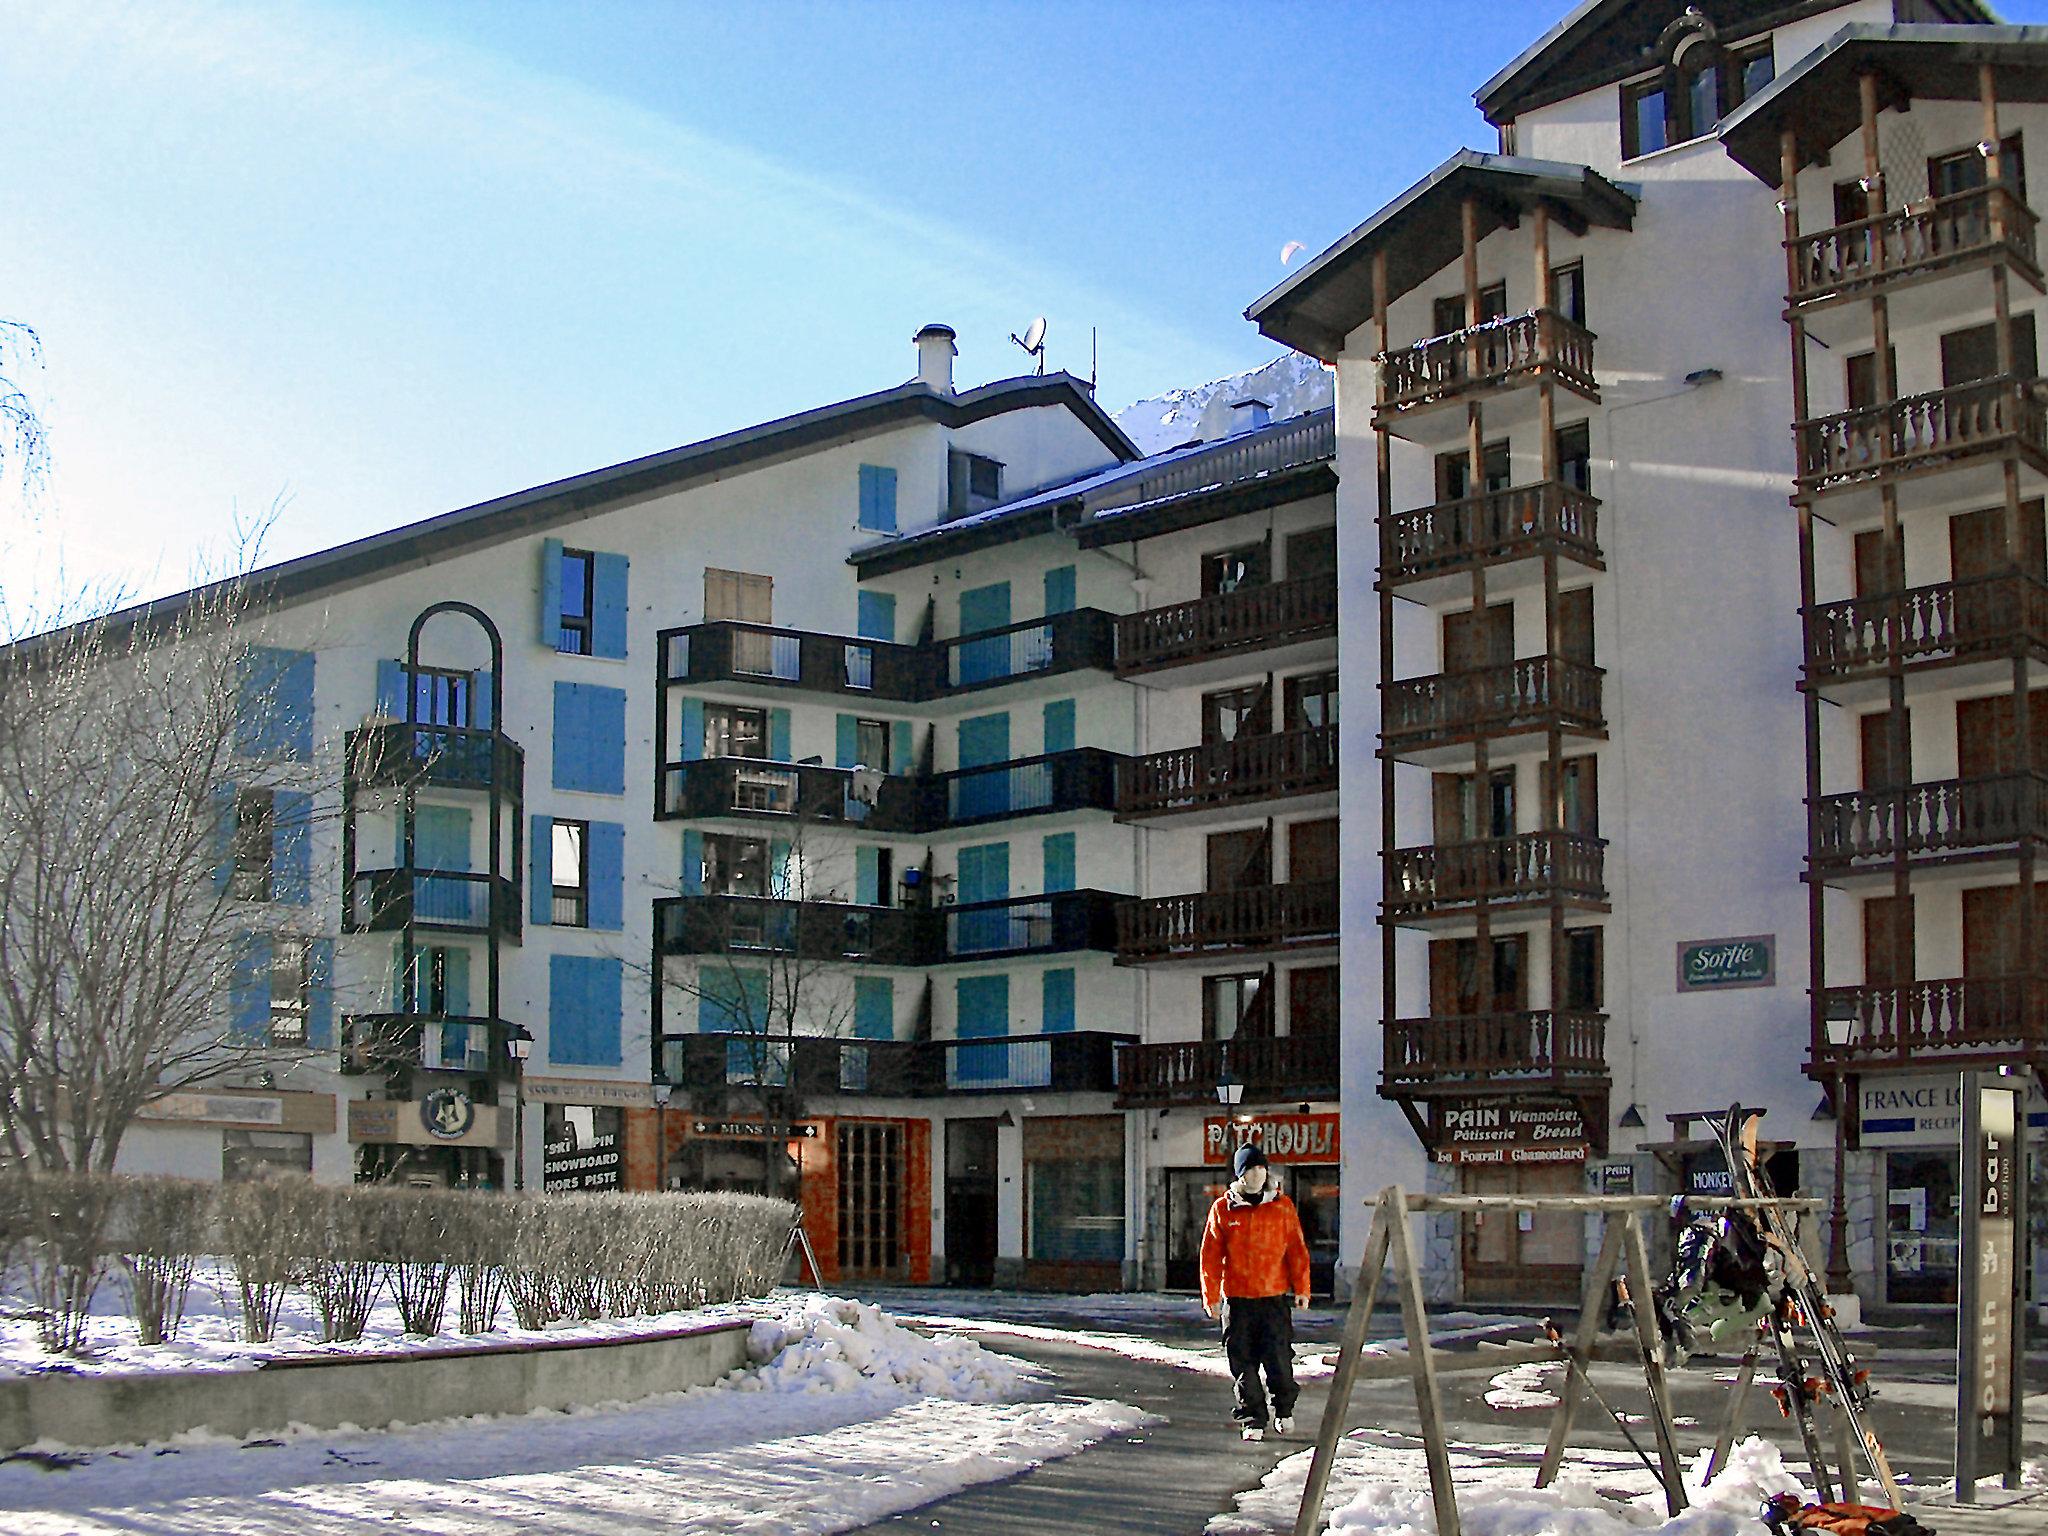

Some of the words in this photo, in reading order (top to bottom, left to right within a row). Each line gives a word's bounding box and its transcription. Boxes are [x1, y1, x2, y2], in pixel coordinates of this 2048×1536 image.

[1692, 943, 1754, 970] Sortie
[1865, 1088, 1937, 1110] FRANCE
[1445, 1109, 1500, 1129] PAIN
[1207, 1121, 1334, 1156] PATCHOULI
[1453, 1128, 1516, 1141] Pâtisserie
[1533, 1122, 1583, 1140] Bread
[548, 1141, 570, 1155] SKI
[545, 1153, 619, 1174] SNOWBOARD
[1605, 1166, 1631, 1175] PAIN
[1983, 1130, 1999, 1213] bar
[545, 1177, 579, 1191] HORS
[584, 1171, 617, 1187] PISTE
[1693, 1171, 1733, 1189] MONKEY
[1981, 1300, 1997, 1437] south
